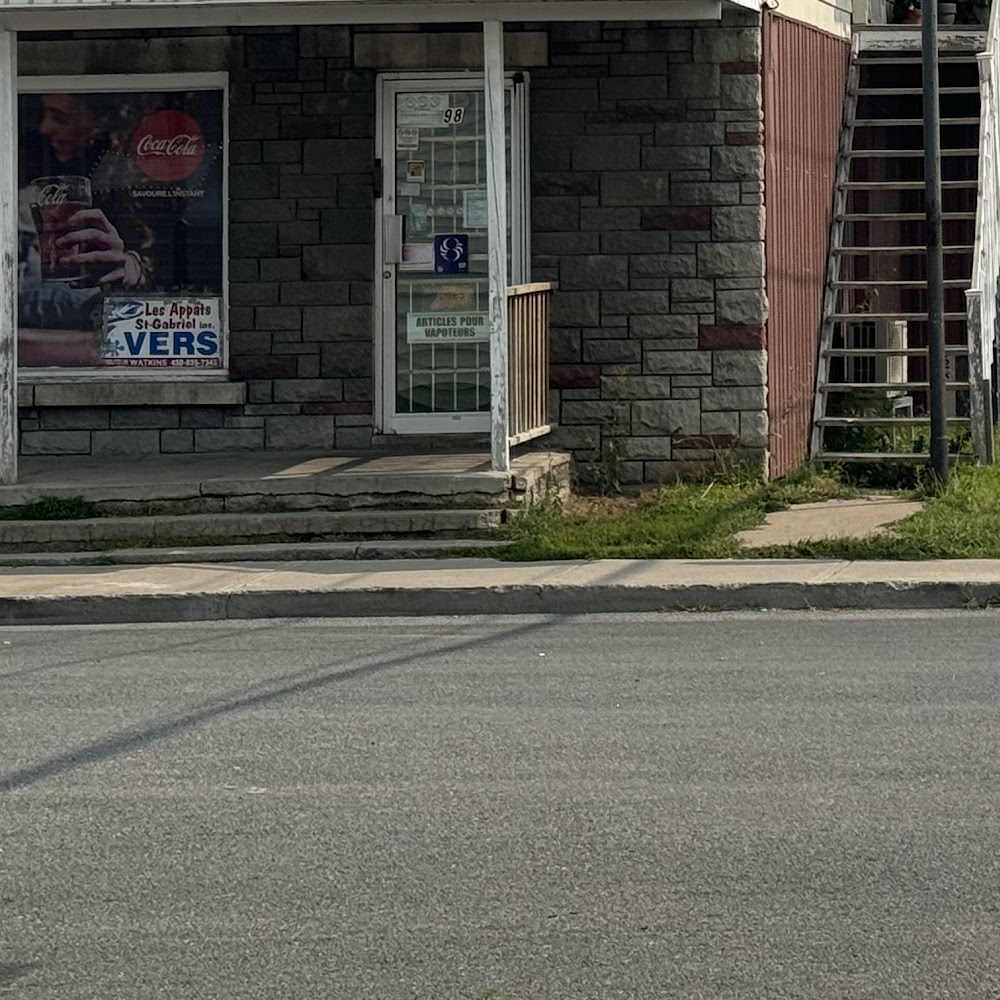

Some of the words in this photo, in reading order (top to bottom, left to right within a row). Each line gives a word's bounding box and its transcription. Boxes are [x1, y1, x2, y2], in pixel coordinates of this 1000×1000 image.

[443, 108, 463, 123] 98
[132, 190, 167, 198] SAVOURE
[145, 303, 165, 316] Les
[135, 318, 196, 330] St-Gabriel
[416, 316, 457, 327] ARTICLES
[460, 316, 484, 326] POUR
[424, 327, 476, 338] VAPOTEURS
[124, 331, 218, 356] VERS
[129, 359, 168, 367] WATKINS
